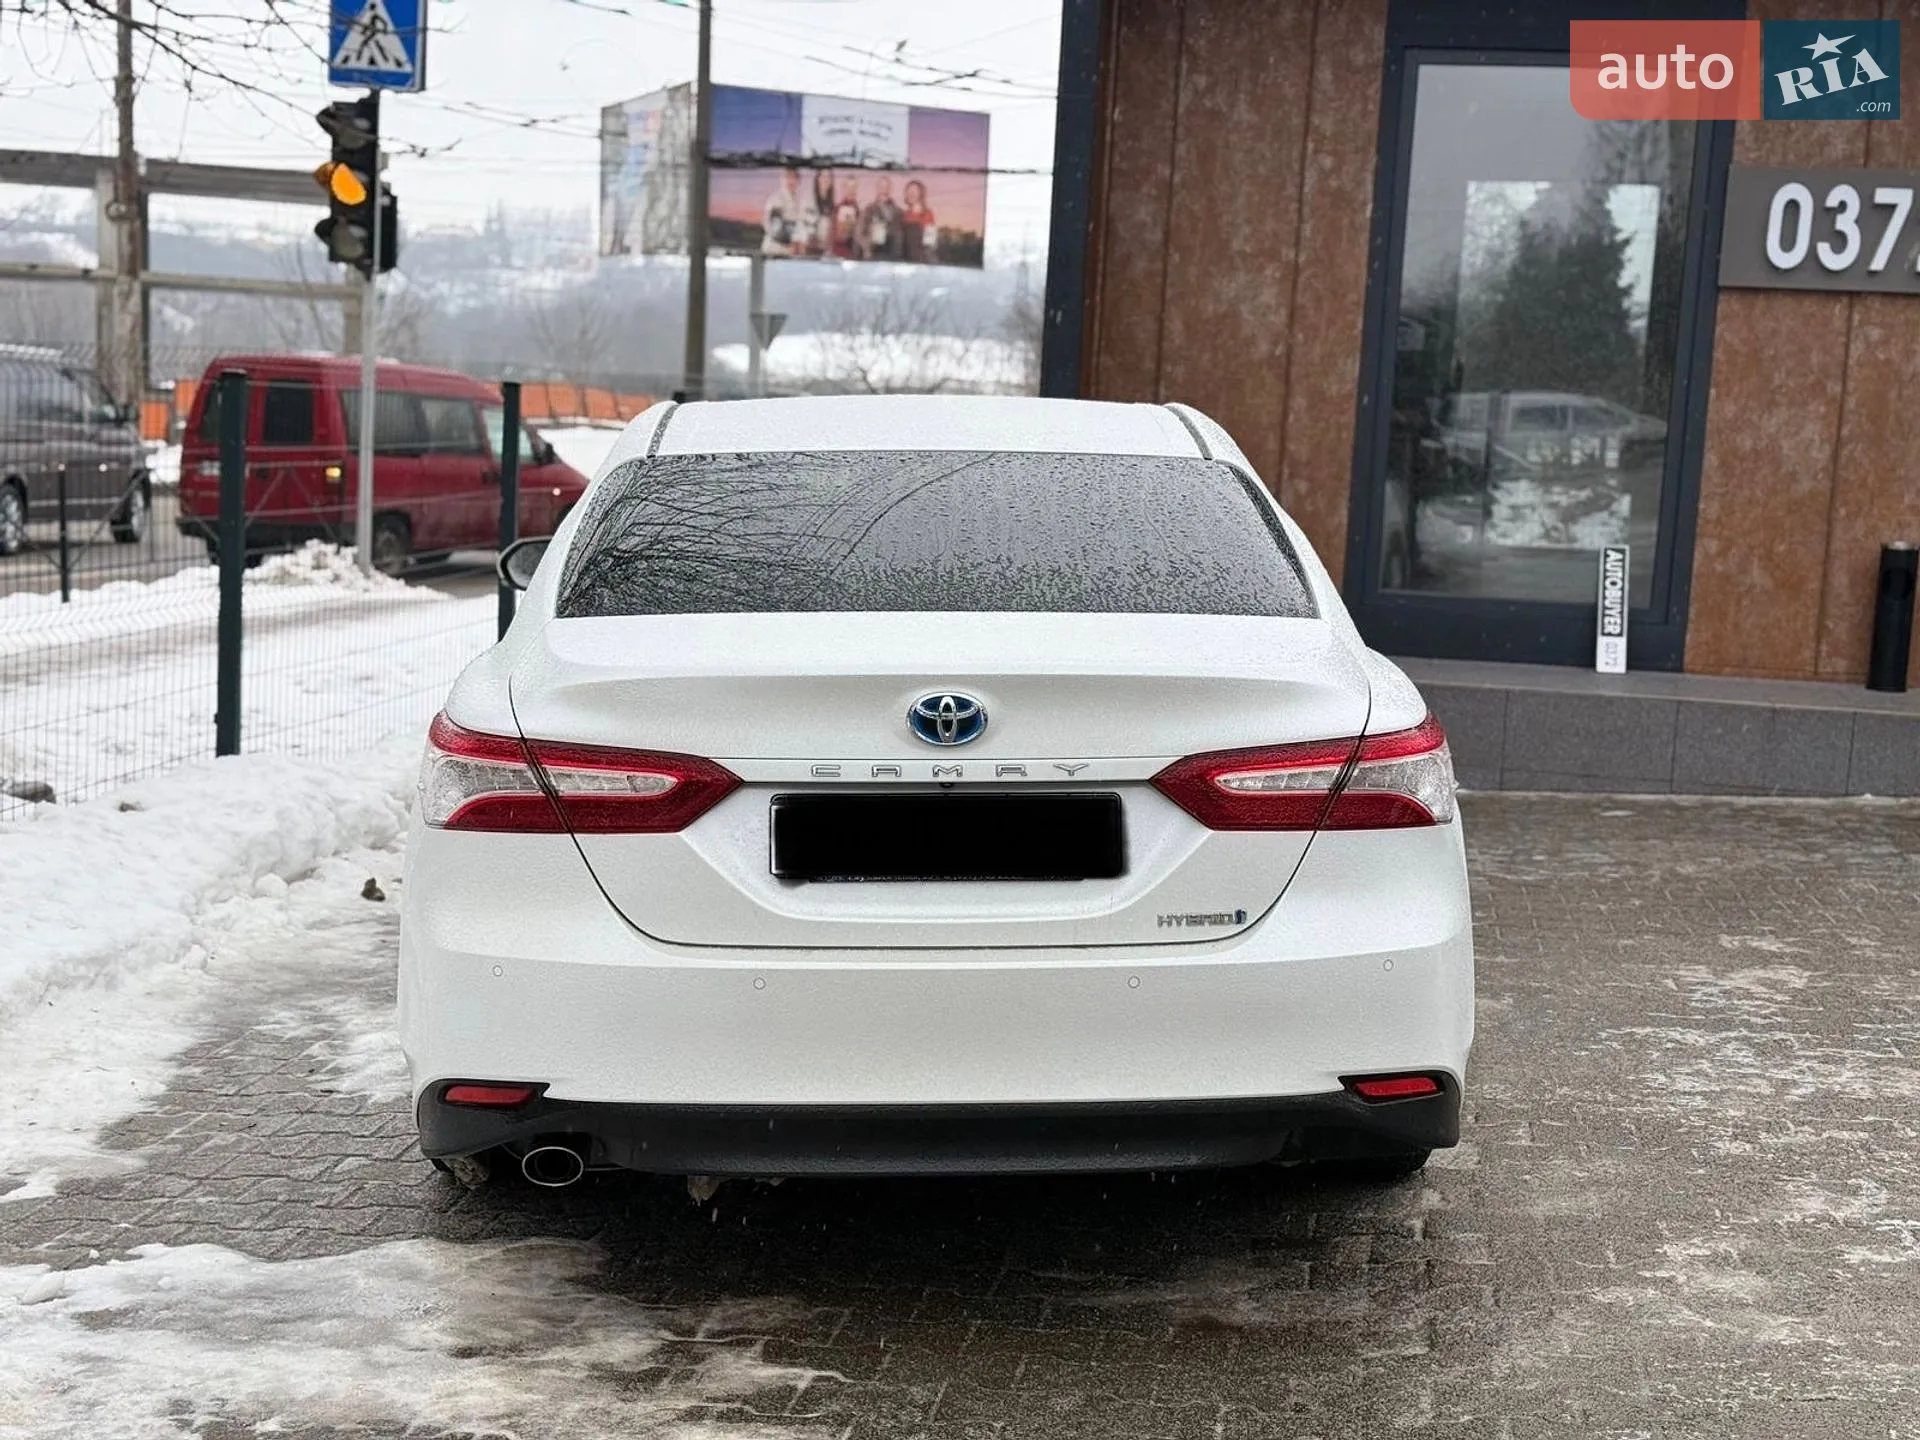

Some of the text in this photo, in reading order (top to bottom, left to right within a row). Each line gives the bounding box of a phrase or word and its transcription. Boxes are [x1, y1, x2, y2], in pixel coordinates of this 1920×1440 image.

[1766, 182, 1920, 272] 037
[1603, 549, 1623, 635] AUTOBUYER
[811, 764, 1089, 778] CAMRY
[1157, 912, 1233, 927] HYBRID
